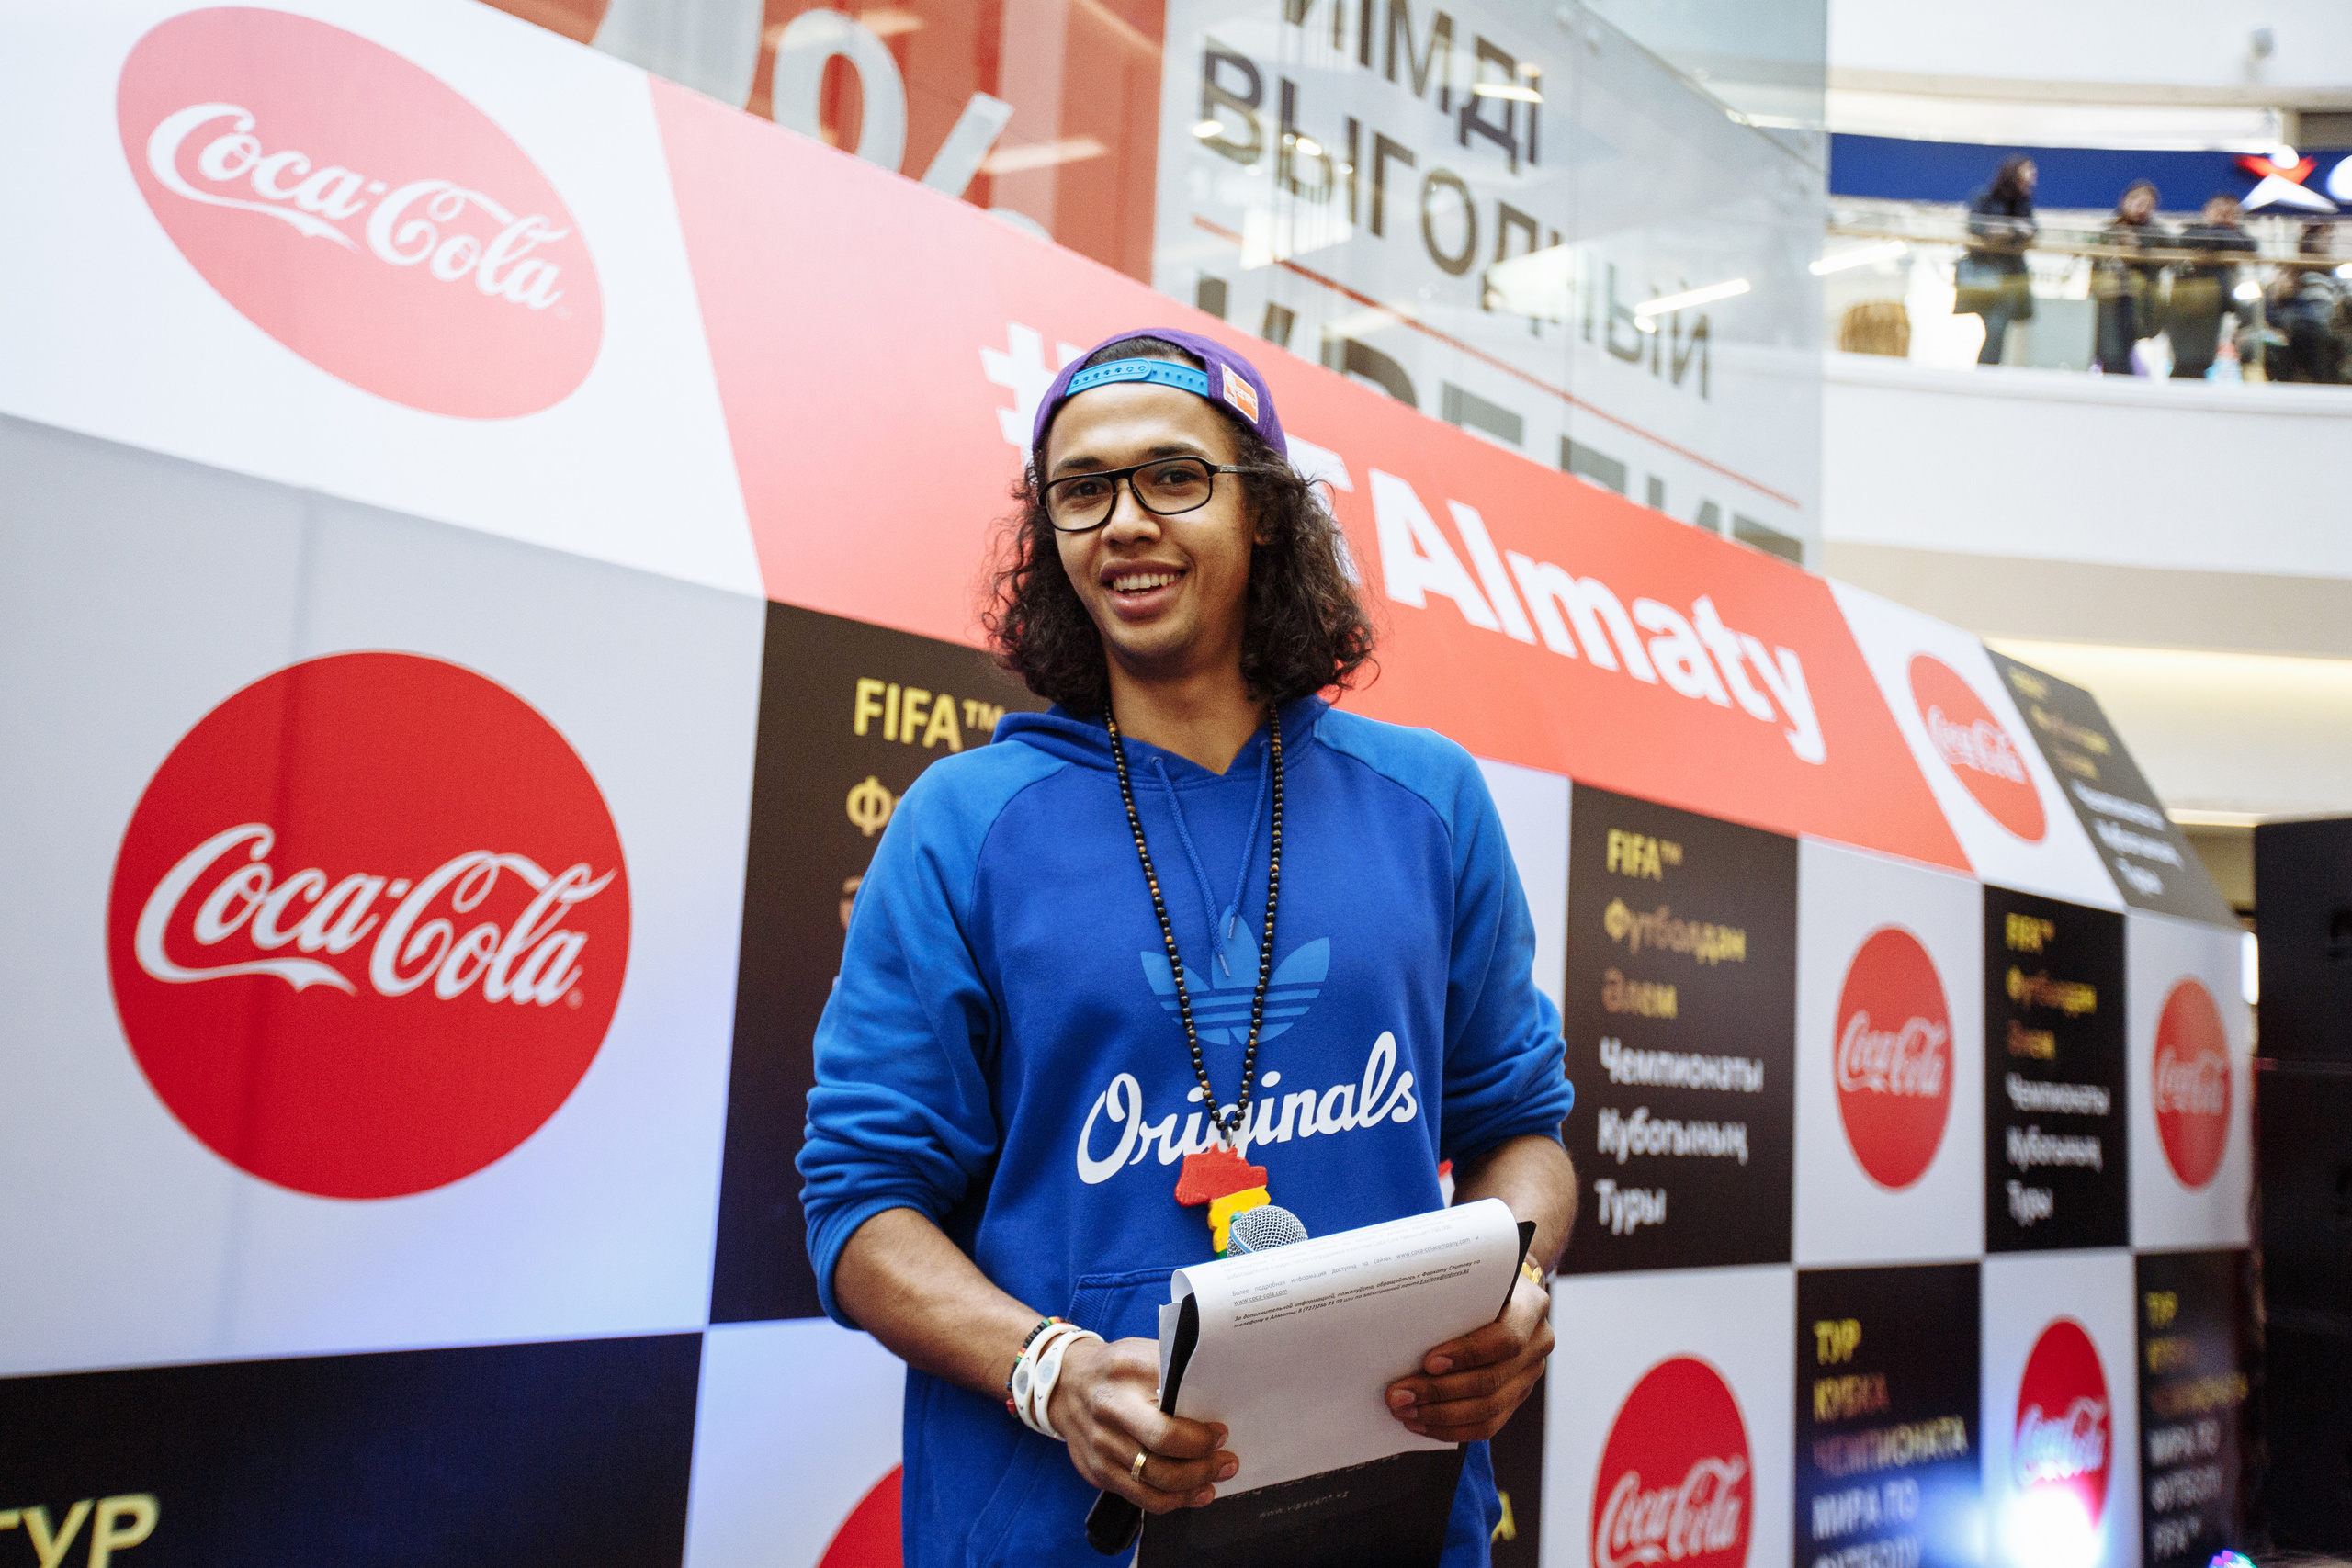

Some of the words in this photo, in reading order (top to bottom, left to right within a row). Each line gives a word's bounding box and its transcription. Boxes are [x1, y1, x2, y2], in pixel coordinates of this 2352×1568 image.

[146, 102, 571, 314] Coca-Cola
[134, 822, 617, 1007] Coca-Cola
[1077, 1031, 1418, 1185] Originals
[1596, 1456, 1745, 1568] Coca-Cola
